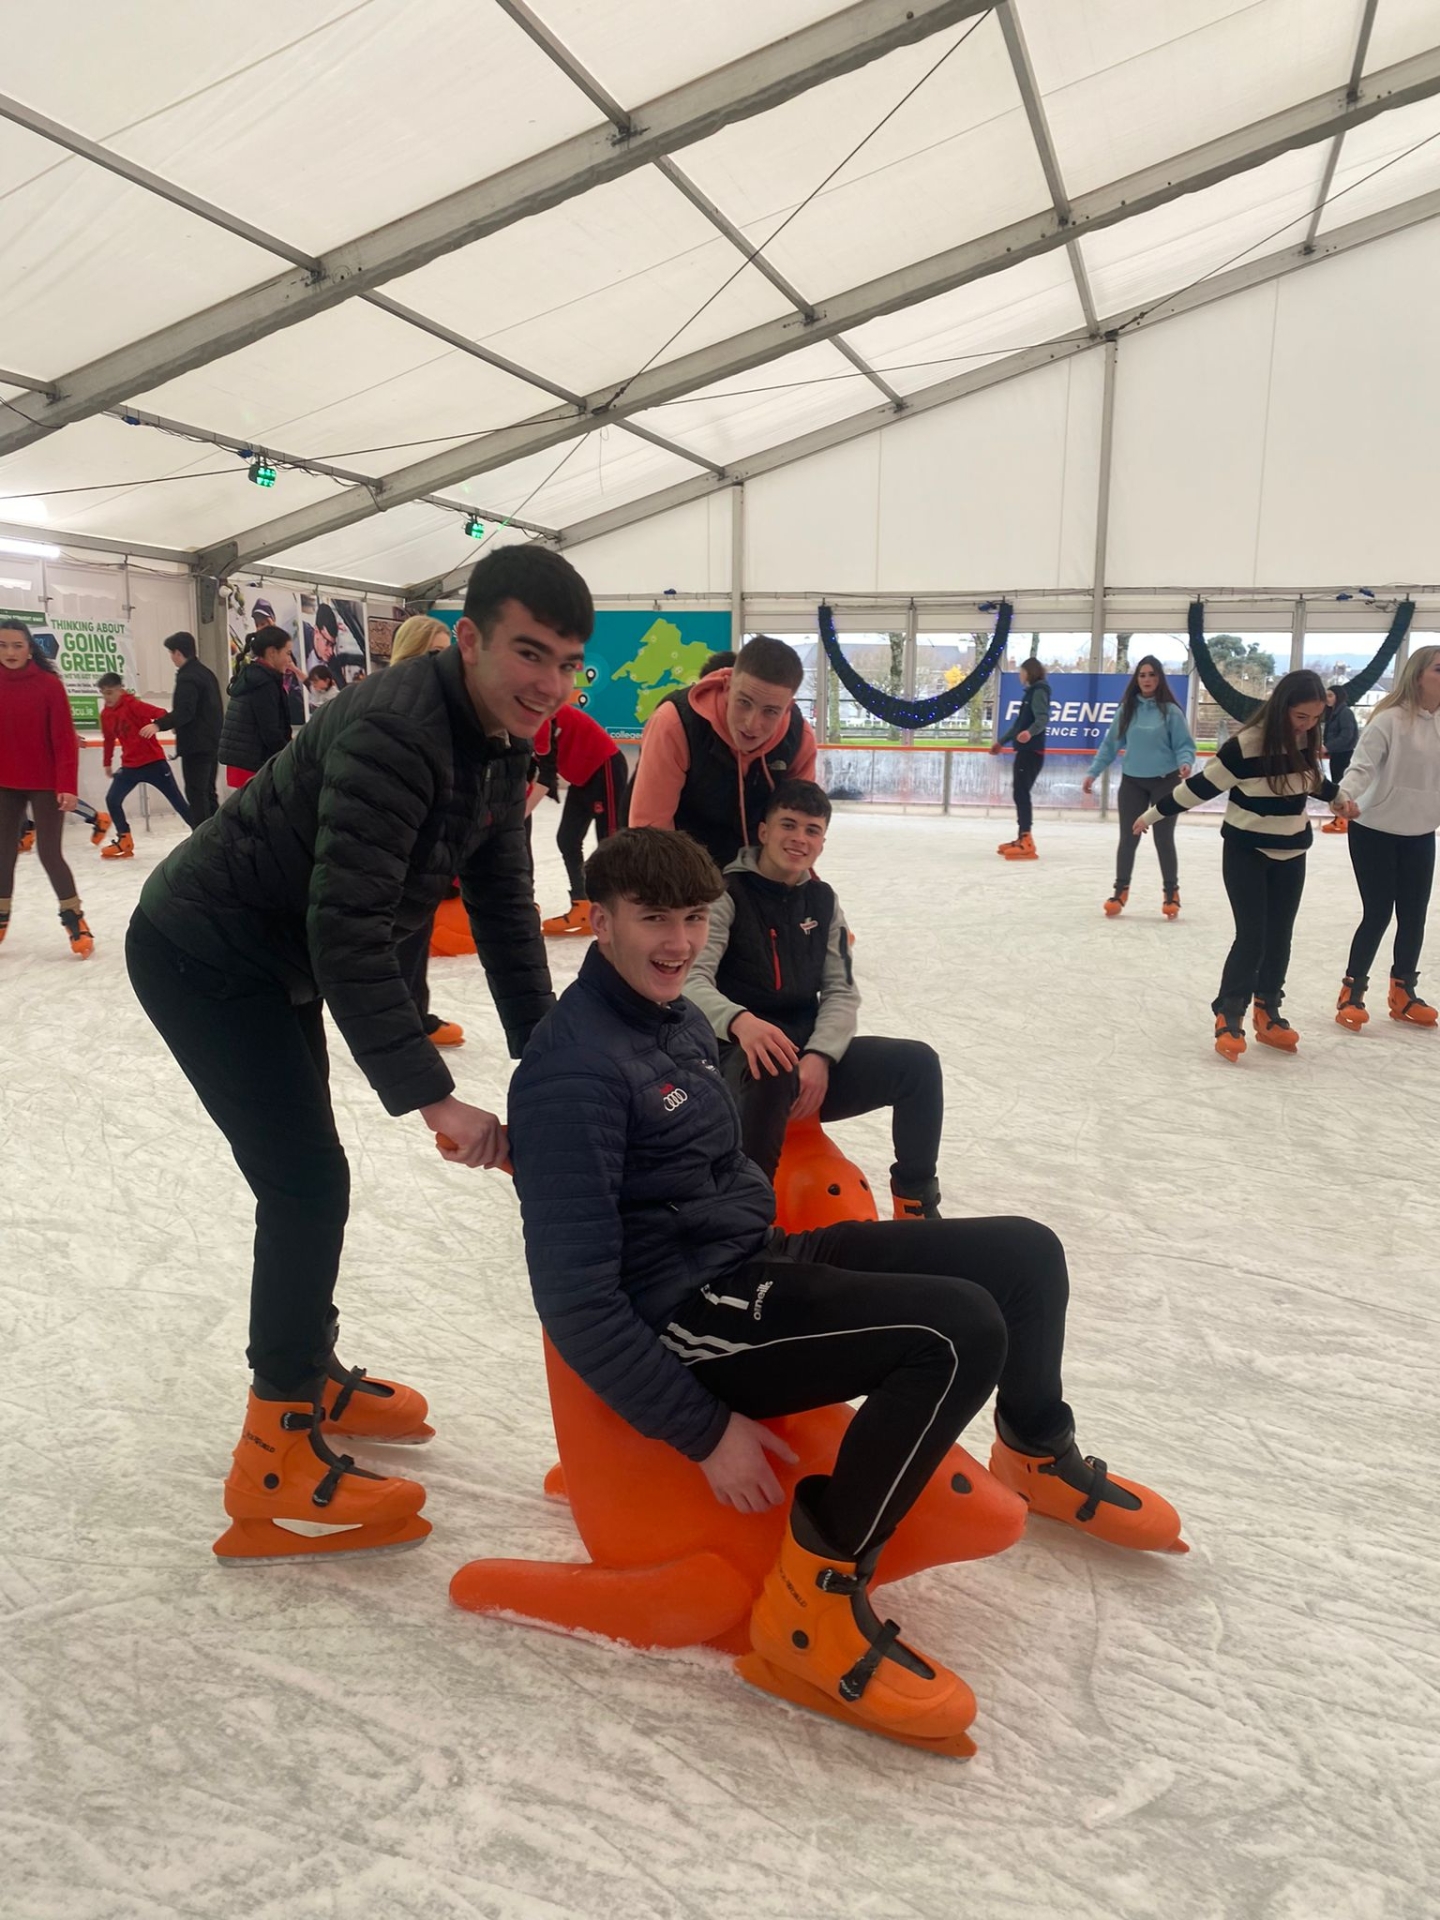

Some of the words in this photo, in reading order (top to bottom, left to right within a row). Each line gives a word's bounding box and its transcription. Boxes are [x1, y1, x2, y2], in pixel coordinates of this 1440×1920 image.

[51, 619, 94, 631] THINKING
[97, 622, 125, 633] ABOUT
[63, 632, 117, 653] GOING
[60, 652, 125, 672] GREEN?
[1005, 701, 1119, 722] RGENE
[1083, 728, 1100, 737] TO
